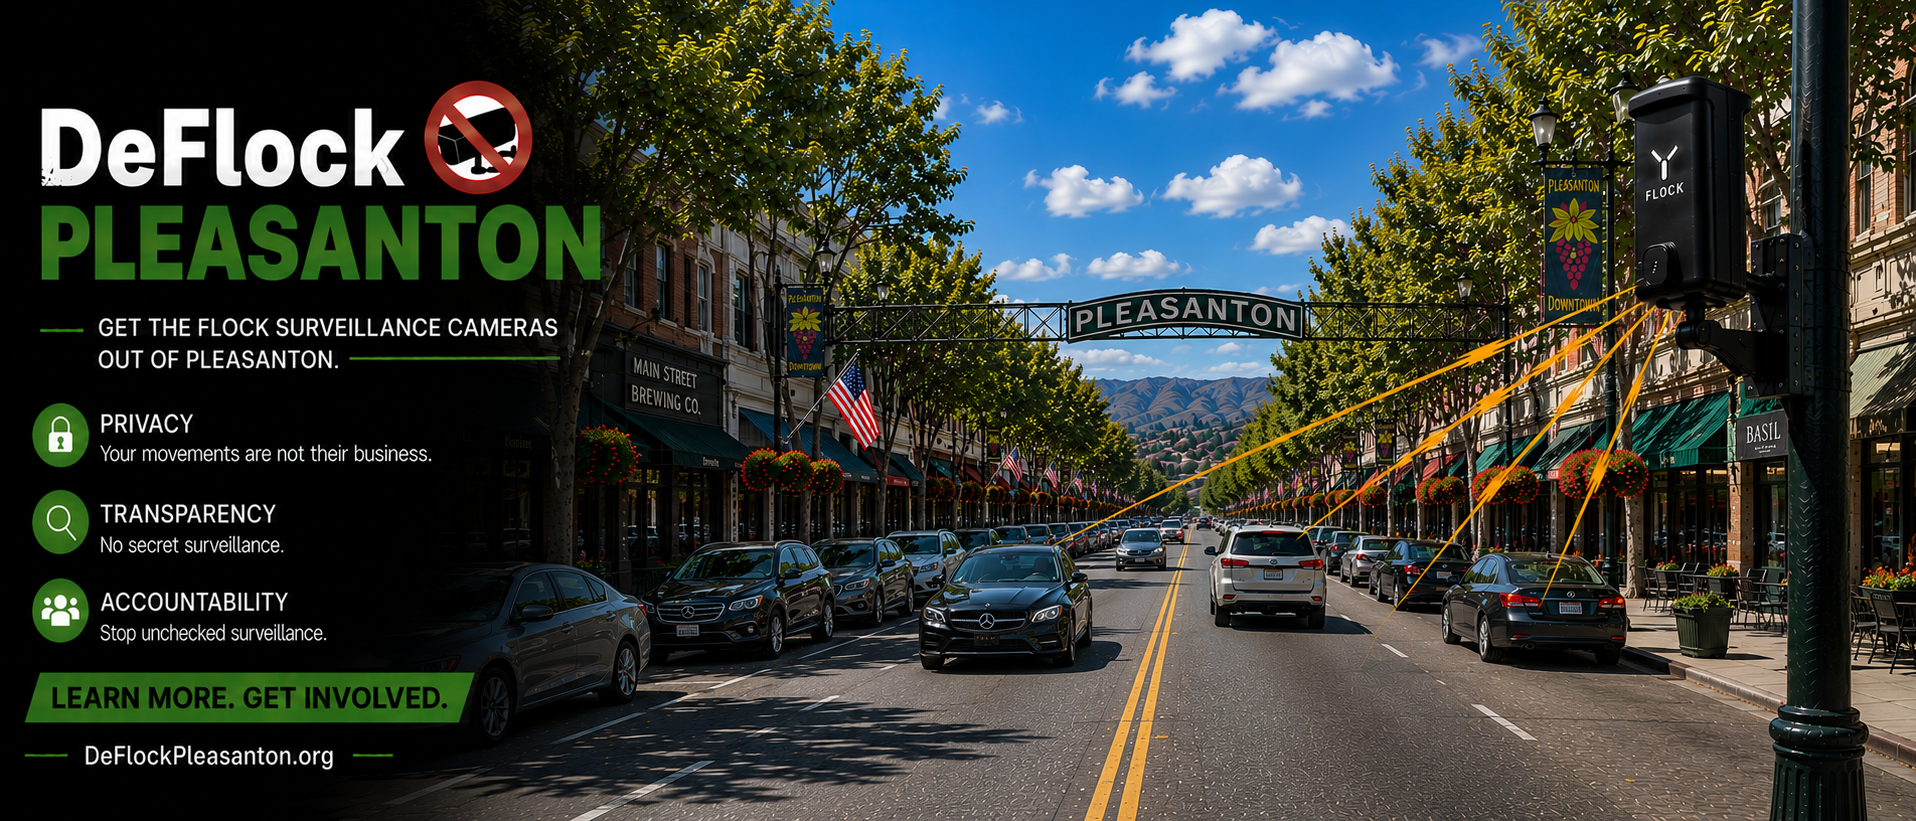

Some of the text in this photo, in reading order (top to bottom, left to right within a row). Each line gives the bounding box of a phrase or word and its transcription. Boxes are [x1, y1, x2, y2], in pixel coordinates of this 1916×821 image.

[1548, 179, 1600, 194] PLEASANTON
[1645, 182, 1684, 202] FLOCK
[1076, 296, 1296, 332] PLEASANTON
[633, 356, 698, 389] MAIN STREET
[631, 384, 702, 415] BREWING CO.
[1746, 421, 1781, 444] BASIL
